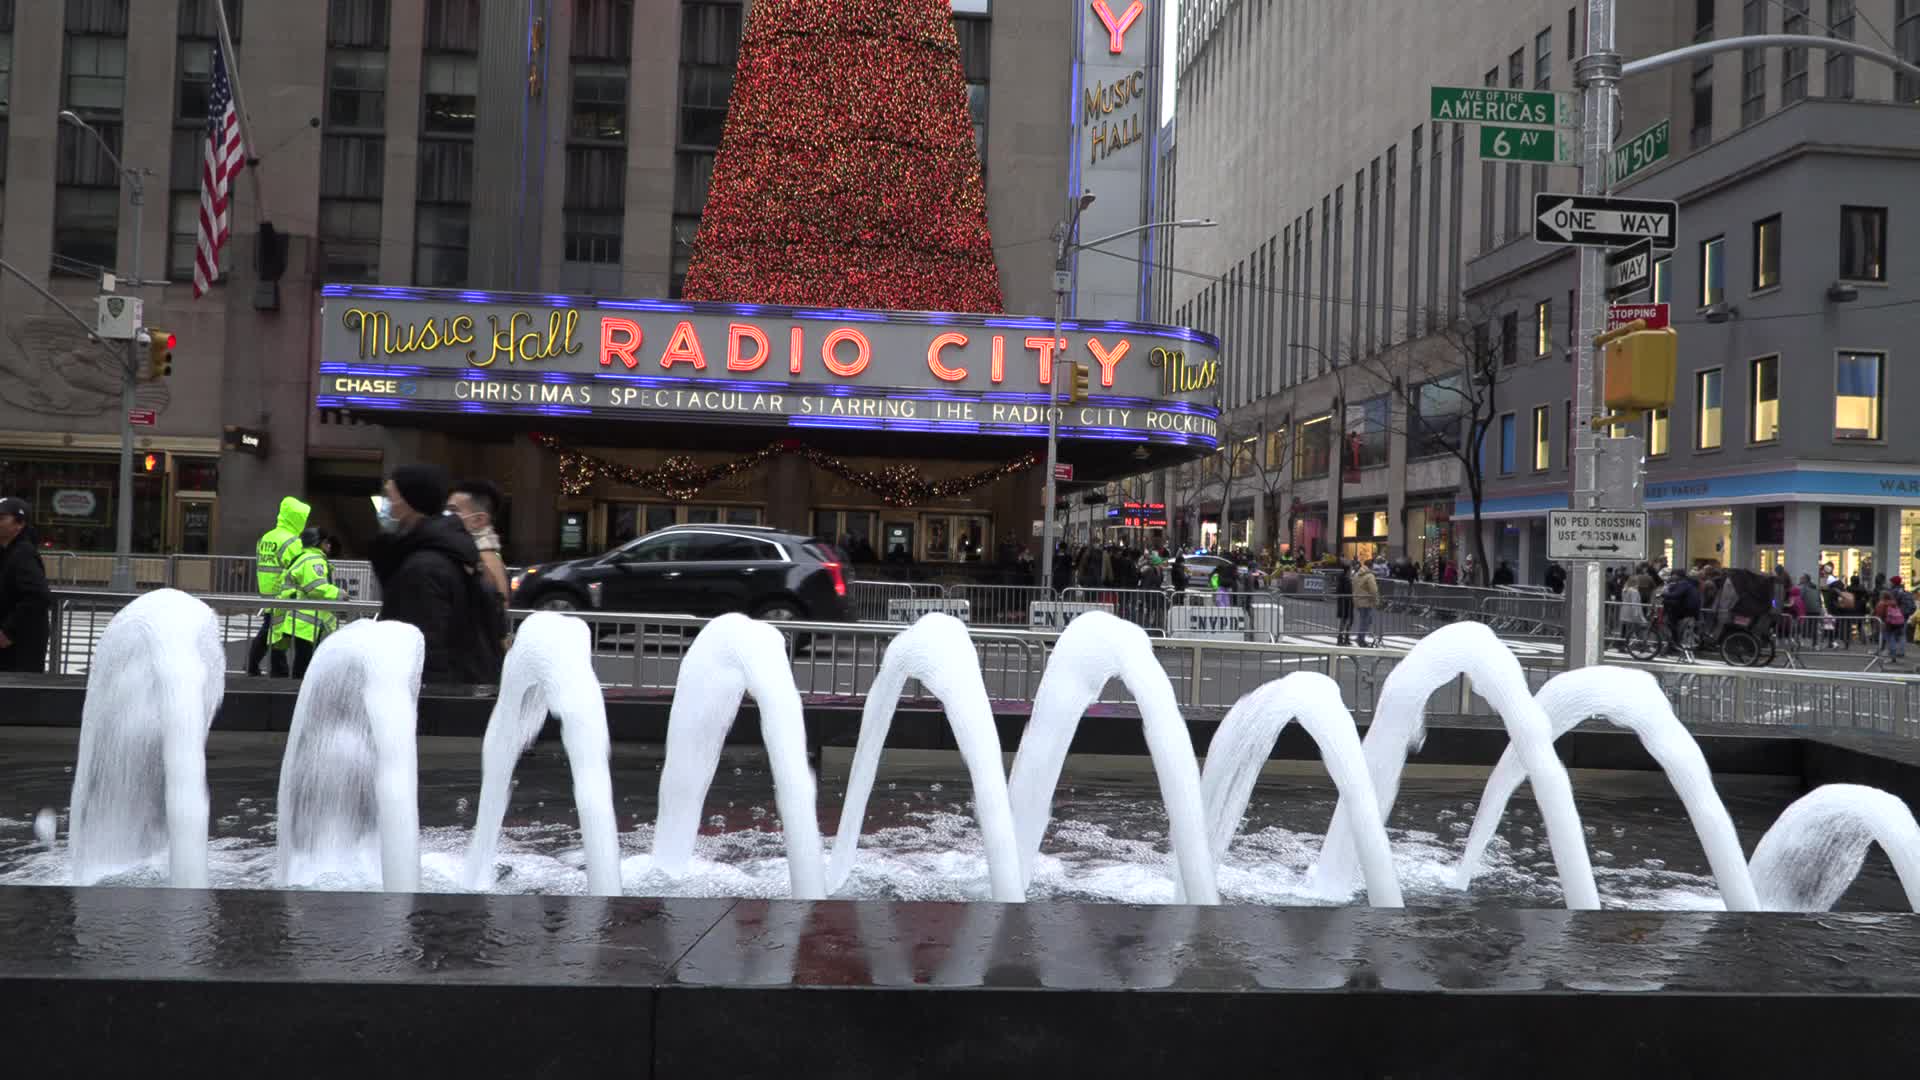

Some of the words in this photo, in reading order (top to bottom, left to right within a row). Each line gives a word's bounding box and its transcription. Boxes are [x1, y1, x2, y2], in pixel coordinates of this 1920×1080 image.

[1092, 0, 1144, 52] Y
[1084, 70, 1144, 126] MUSIC
[1461, 90, 1481, 100] AVE
[1486, 91, 1500, 101] OF
[1504, 92, 1524, 102] THE
[1439, 101, 1547, 123] AMERICAS
[1090, 112, 1142, 165] HALL
[1493, 131, 1511, 156] 6
[1519, 132, 1539, 145] AV
[1617, 147, 1629, 179] W
[1633, 133, 1655, 170] 50
[1656, 124, 1668, 144] ST
[1554, 210, 1596, 230] ONE
[1620, 214, 1664, 233] WAY
[1619, 255, 1645, 282] WAY
[1608, 309, 1657, 319] STOPPING
[343, 307, 474, 359] Music
[466, 308, 583, 368] Hall
[600, 317, 871, 377] RADIO
[927, 331, 1131, 388] CITY
[335, 378, 397, 393] CHASE
[455, 381, 591, 404] CHRISTMAS
[610, 387, 783, 412] SPECTACULAR
[801, 396, 915, 418] STARRING
[937, 402, 974, 420] THE
[992, 404, 1063, 424] RADIO
[1080, 408, 1130, 427] CITY
[1554, 517, 1567, 527] NO
[1595, 517, 1642, 528] CROSSING
[1558, 531, 1577, 541] USE
